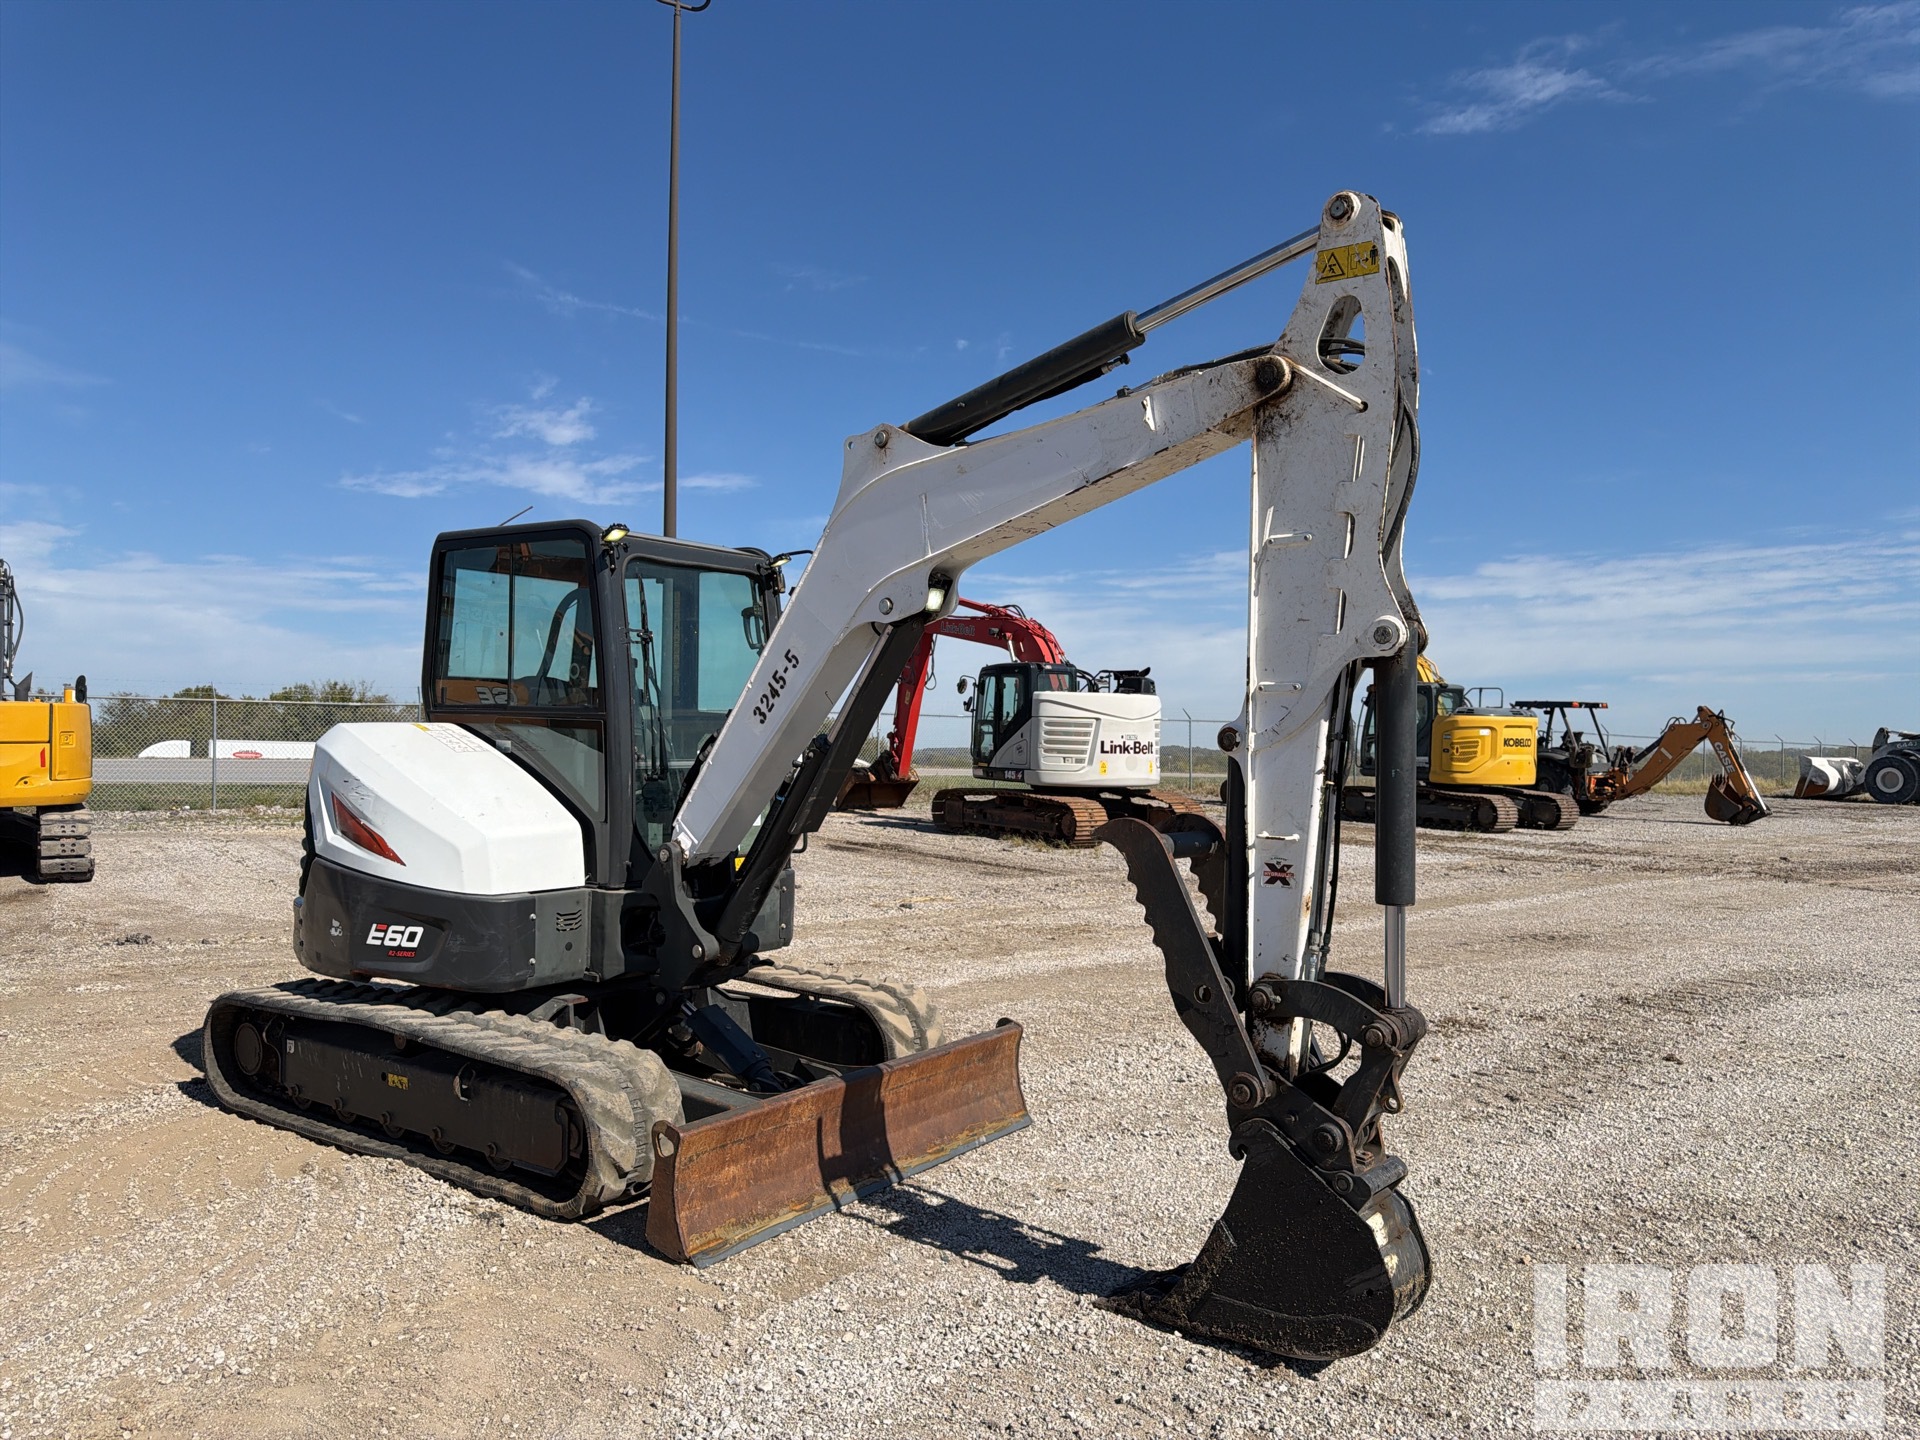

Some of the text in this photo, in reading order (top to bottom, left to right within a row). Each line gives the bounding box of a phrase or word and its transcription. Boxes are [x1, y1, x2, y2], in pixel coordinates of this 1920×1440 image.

[753, 648, 799, 724] 3245-5
[1503, 737, 1532, 748] KOBELCO
[1714, 741, 1736, 774] CASE
[366, 923, 424, 948] E60
